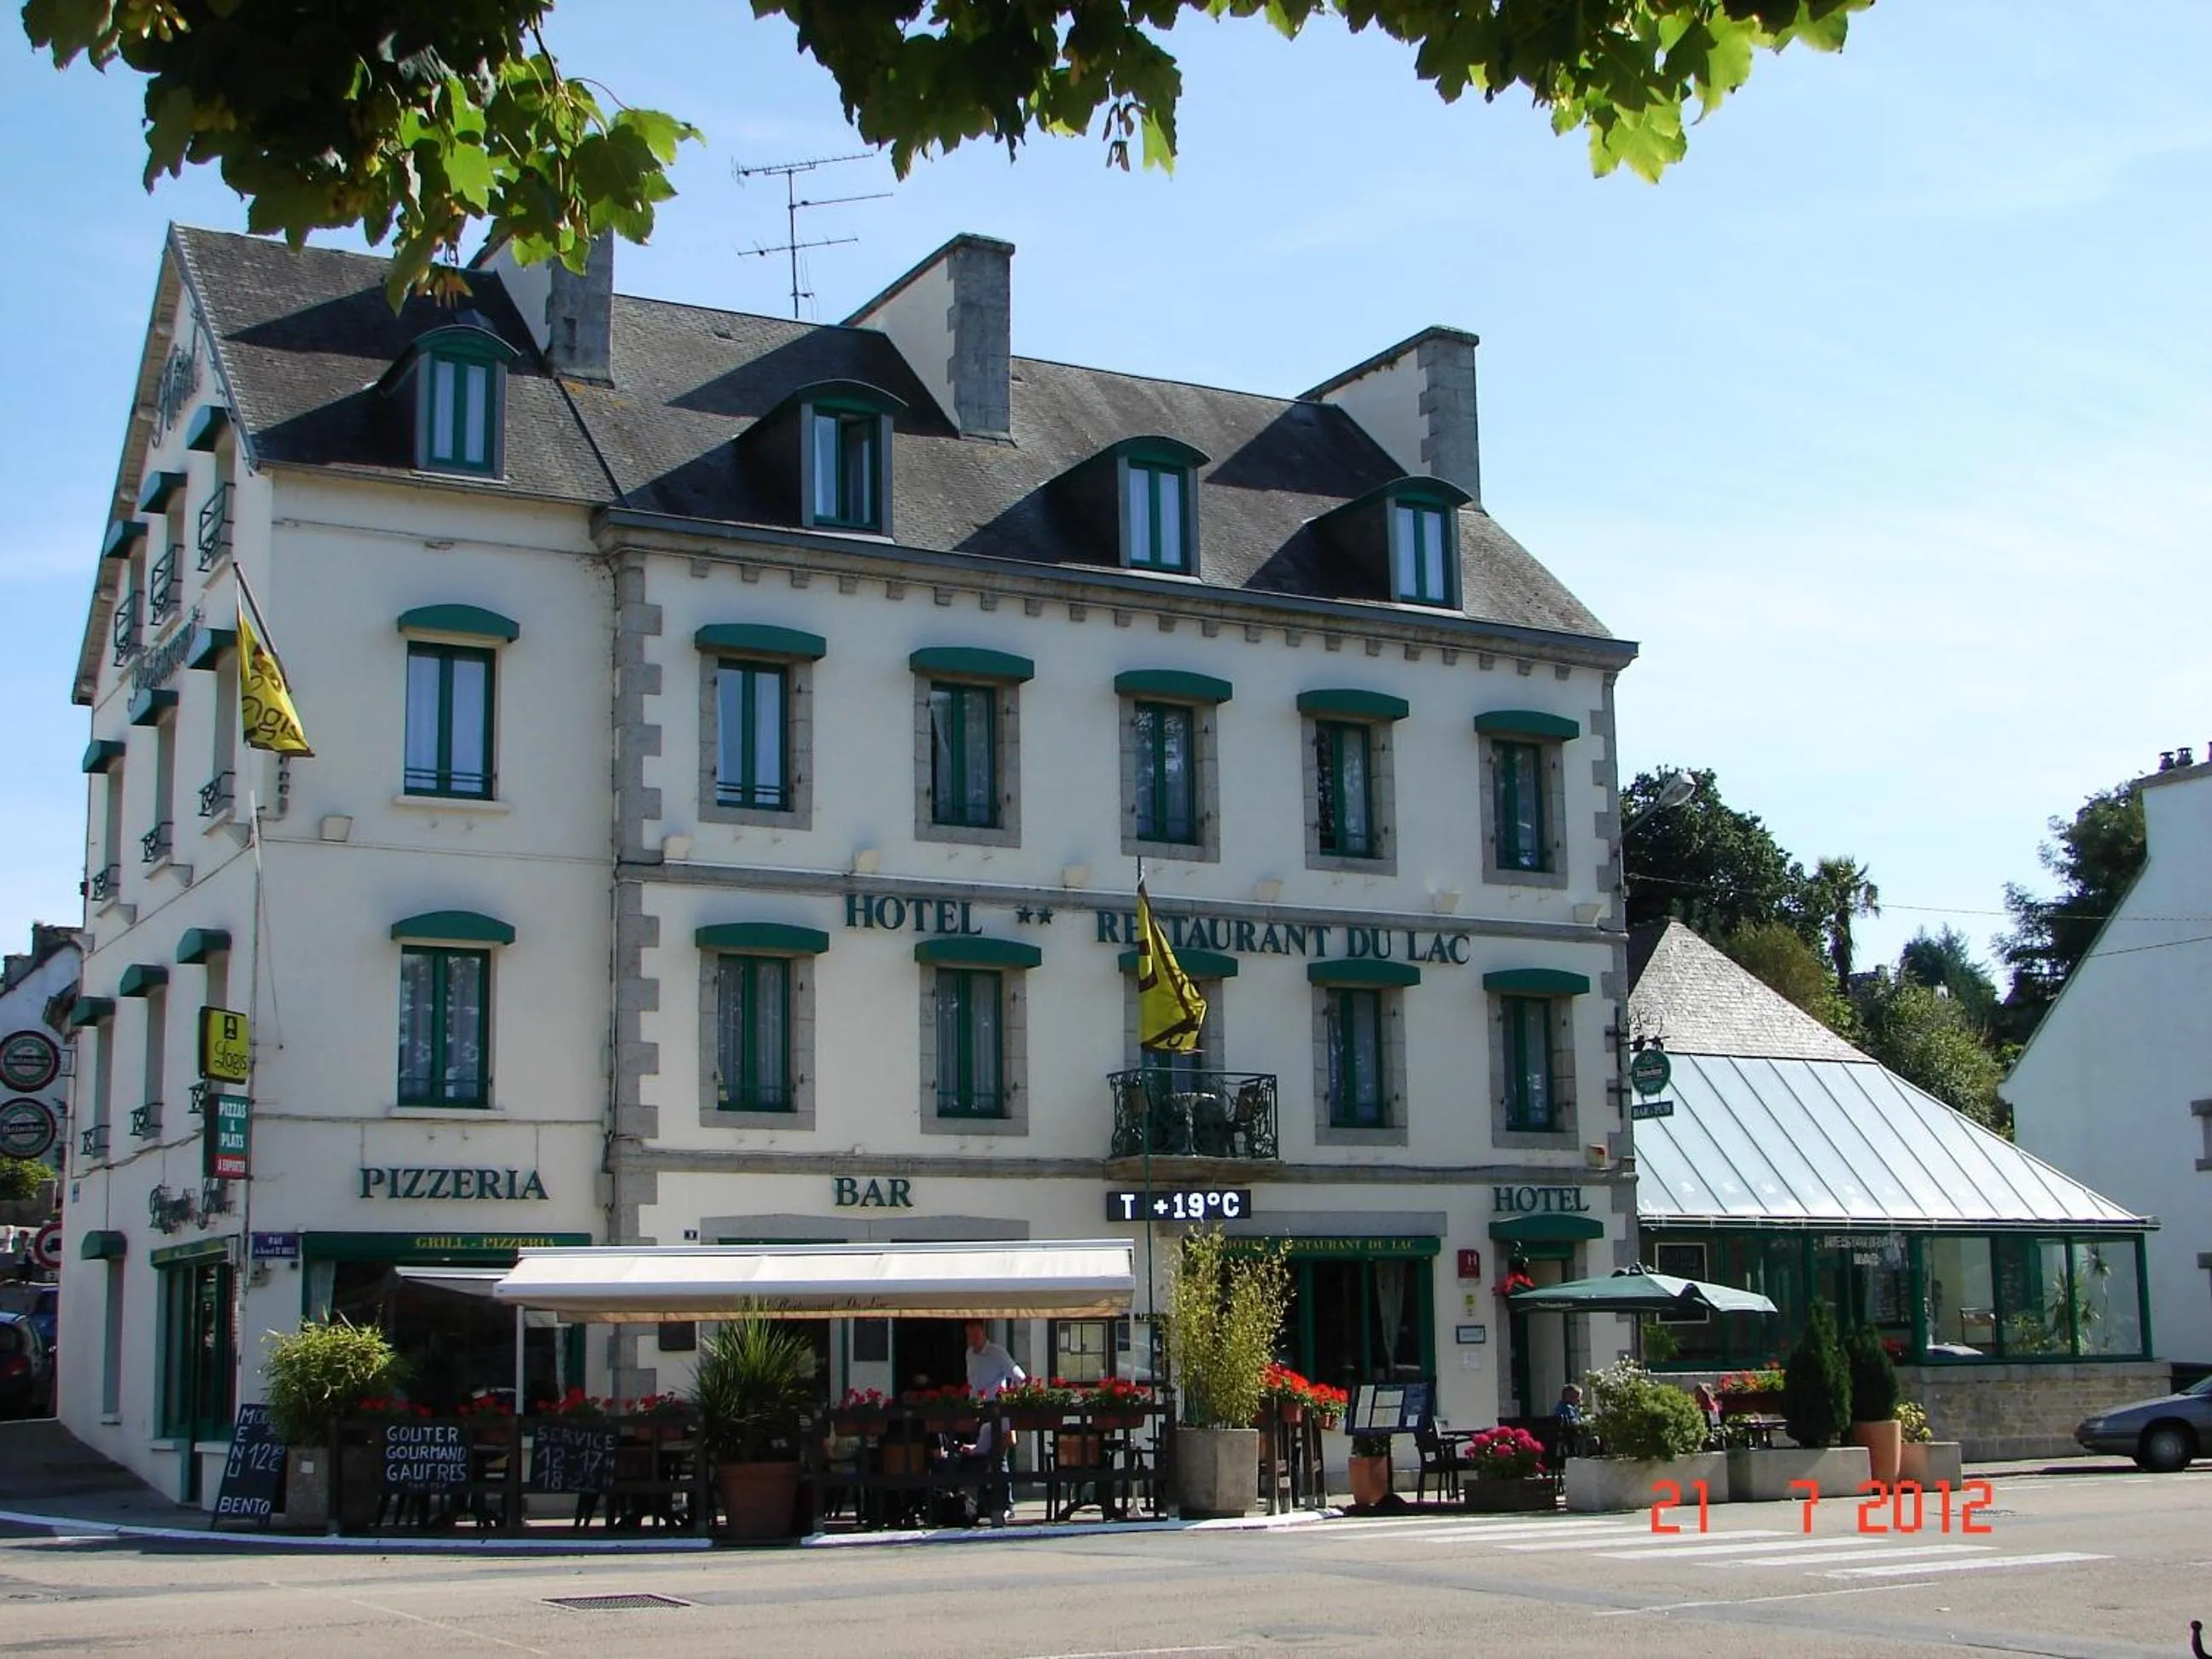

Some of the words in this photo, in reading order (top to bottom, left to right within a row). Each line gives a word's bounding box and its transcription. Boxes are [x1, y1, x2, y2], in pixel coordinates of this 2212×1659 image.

[844, 894, 982, 934] HOTEL
[1096, 911, 1331, 958] RETAURANT
[1347, 926, 1392, 959] DU
[1406, 929, 1470, 965] LAC
[213, 1039, 248, 1076] Logis
[218, 1102, 247, 1119] PIZZAS
[220, 1132, 244, 1149] PLATS
[359, 1167, 550, 1199] PIZZERIA
[834, 1178, 914, 1207] BAR
[1120, 1194, 1135, 1220] T
[1153, 1192, 1240, 1219] +19°C
[1493, 1186, 1590, 1212] HOTEL
[415, 1237, 467, 1249] GRILL
[482, 1237, 555, 1249] PIZZERIA
[1369, 1239, 1386, 1250] DU
[1392, 1240, 1417, 1251] LAC
[1468, 1254, 1476, 1266] H
[387, 1425, 459, 1443] GOUTER
[537, 1426, 614, 1451] SERVICE
[386, 1445, 468, 1462] GOURMAND
[387, 1463, 467, 1481] GAUFRES
[218, 1495, 271, 1515] BENTO
